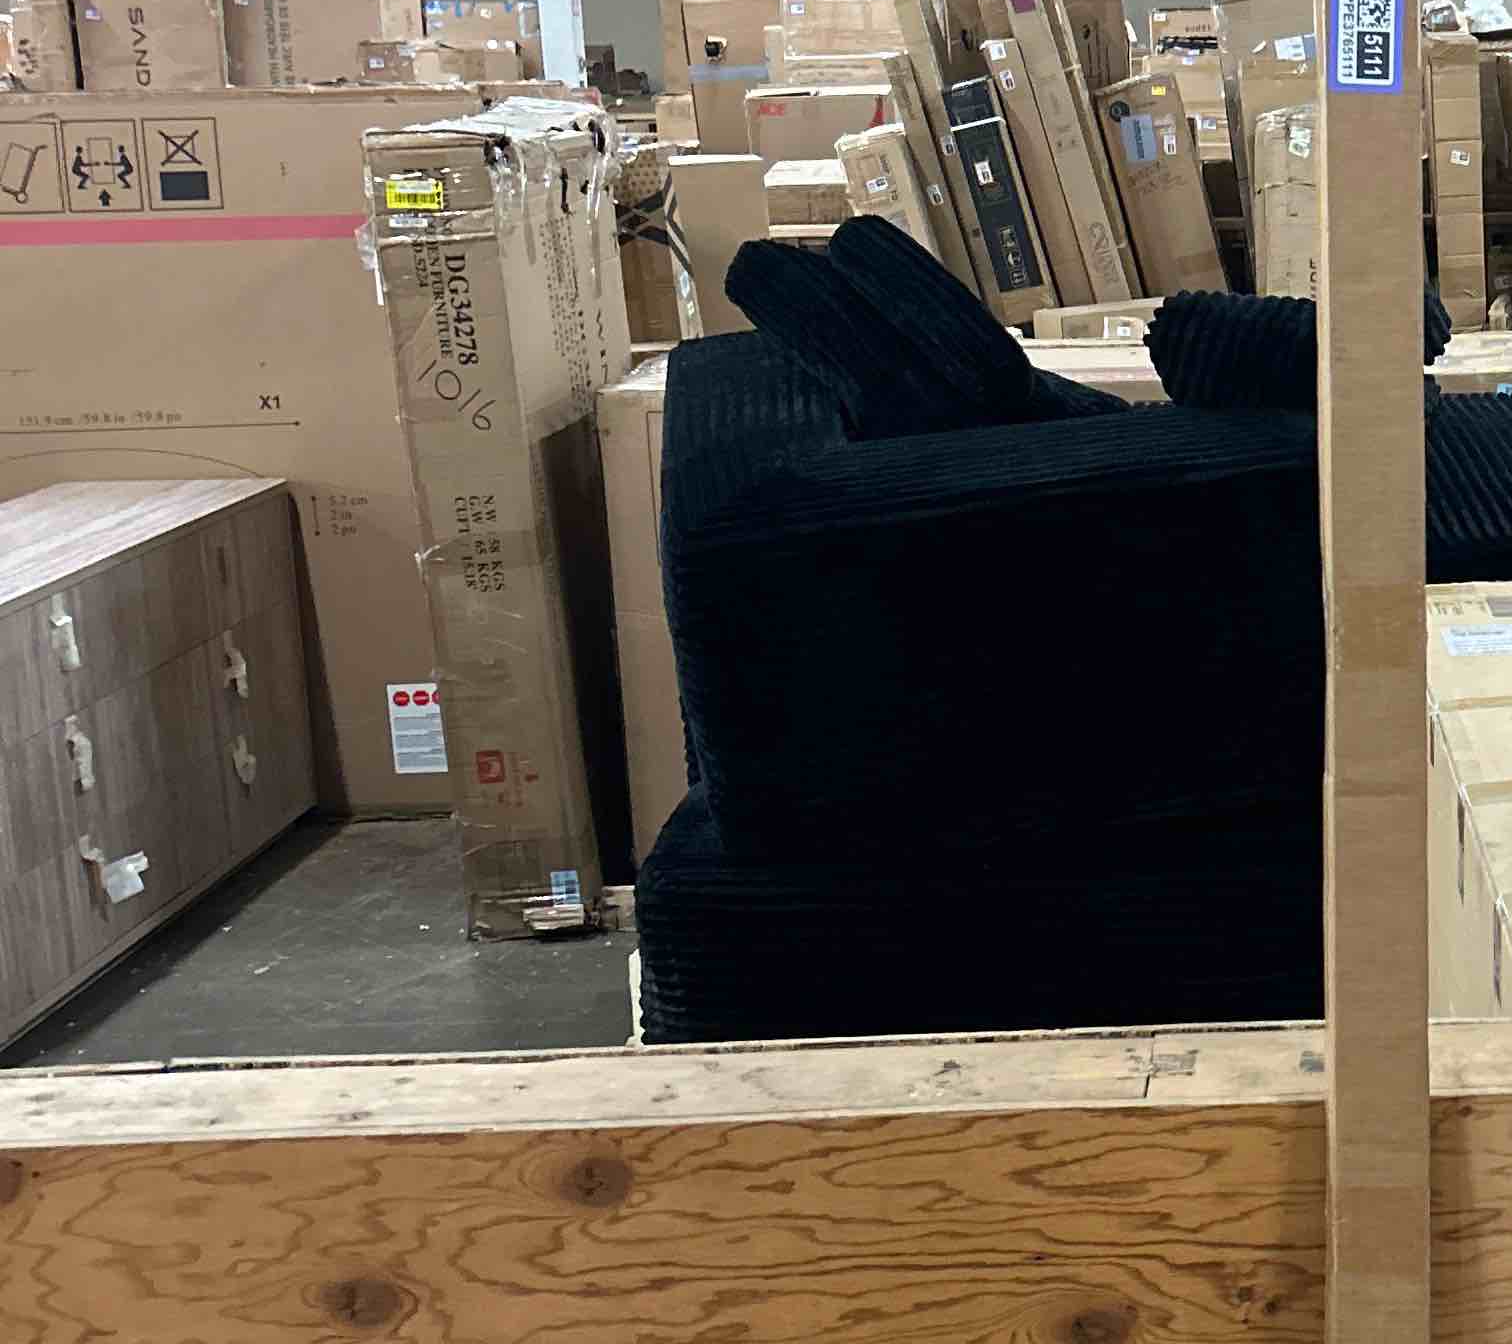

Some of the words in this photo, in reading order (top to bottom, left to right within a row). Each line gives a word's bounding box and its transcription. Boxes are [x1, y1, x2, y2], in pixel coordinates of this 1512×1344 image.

[1362, 32, 1384, 78] 5111
[430, 271, 454, 358] FURNITURE
[445, 255, 479, 366] DG34278
[258, 395, 282, 410] X1
[477, 562, 493, 593] KGS
[491, 560, 505, 592] KGS
